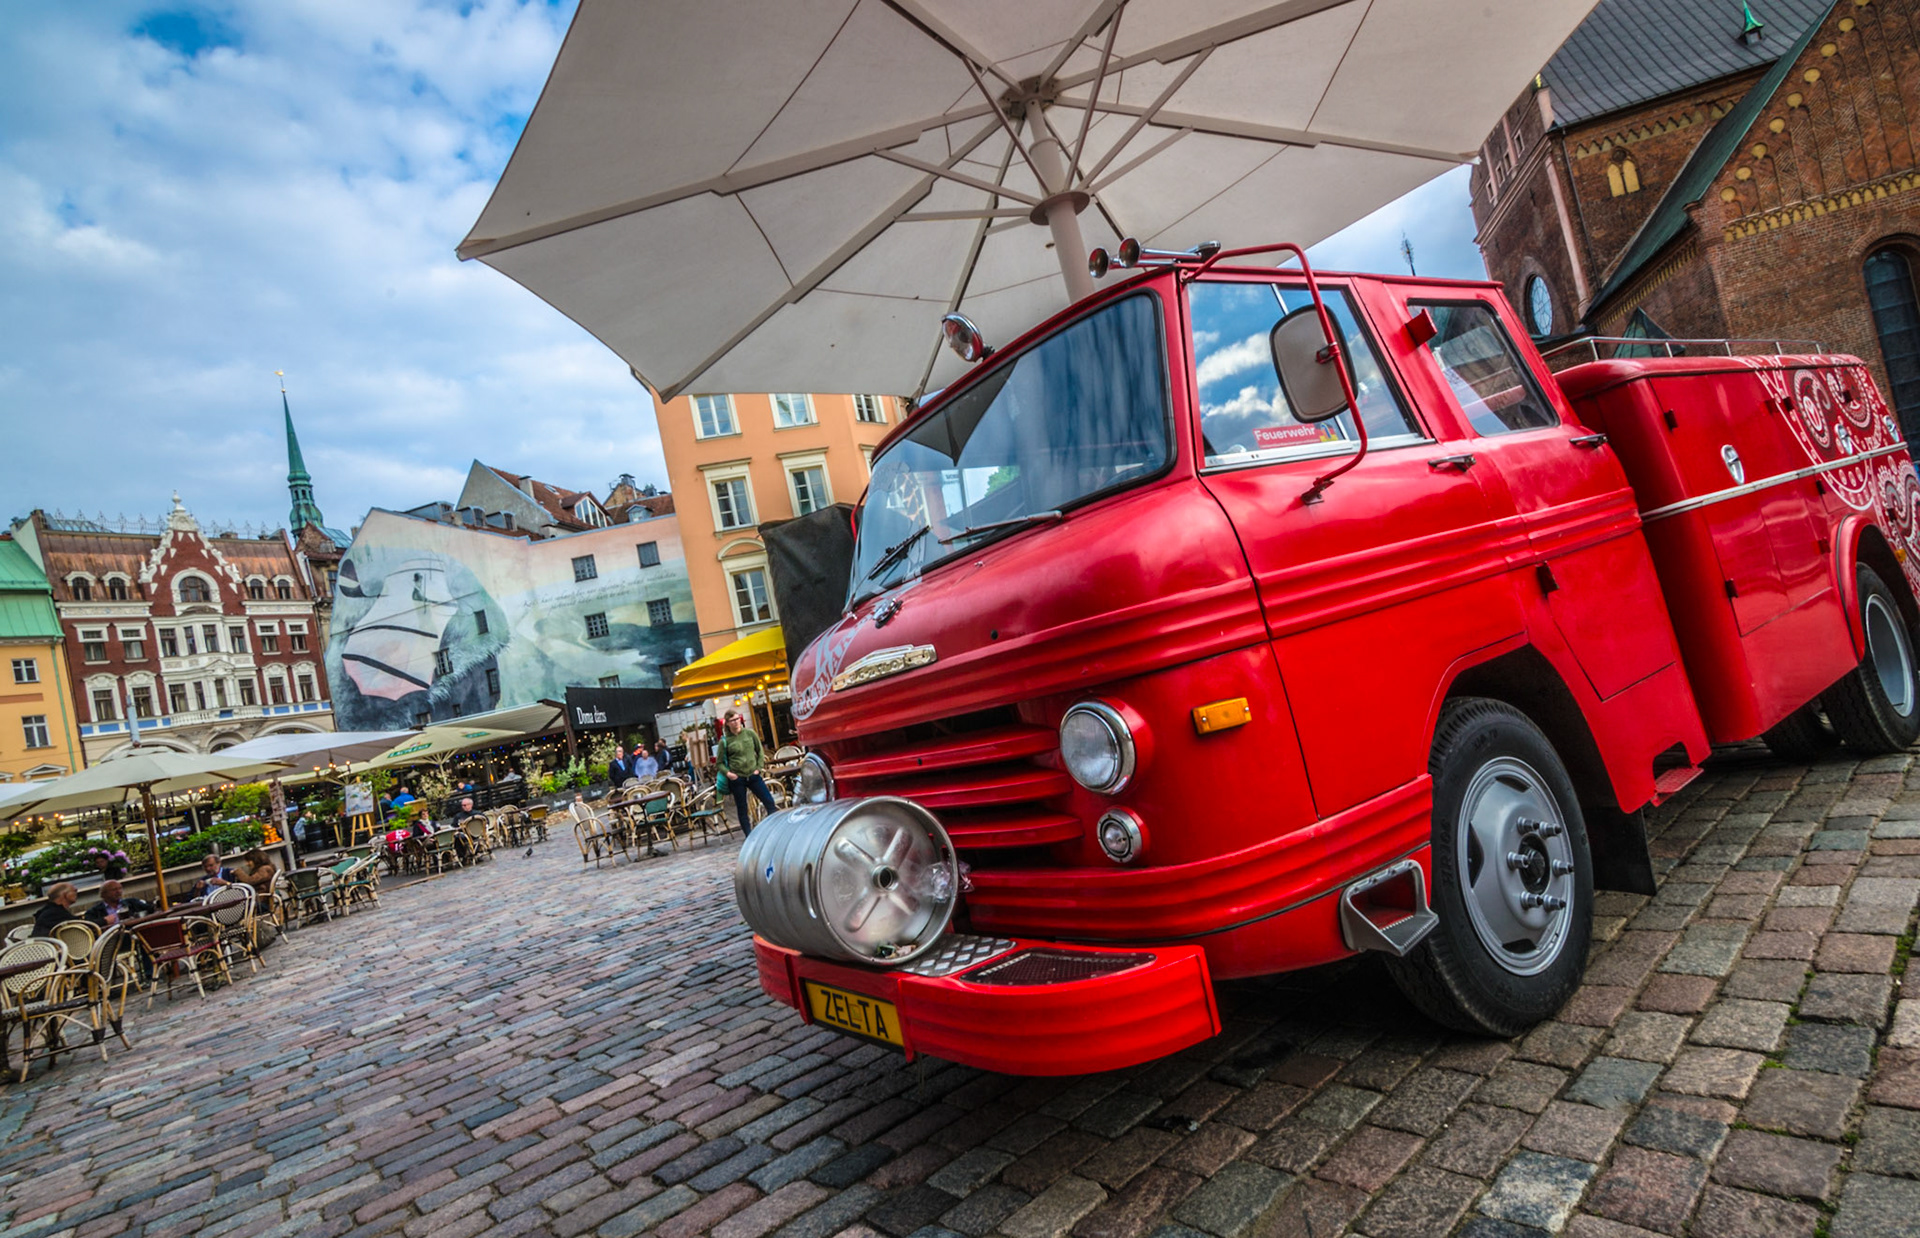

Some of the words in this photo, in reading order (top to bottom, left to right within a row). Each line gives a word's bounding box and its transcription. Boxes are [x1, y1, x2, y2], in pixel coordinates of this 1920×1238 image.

[1254, 426, 1316, 441] Feuerwehr
[576, 706, 594, 724] Doma
[821, 990, 889, 1038] ZELTA
